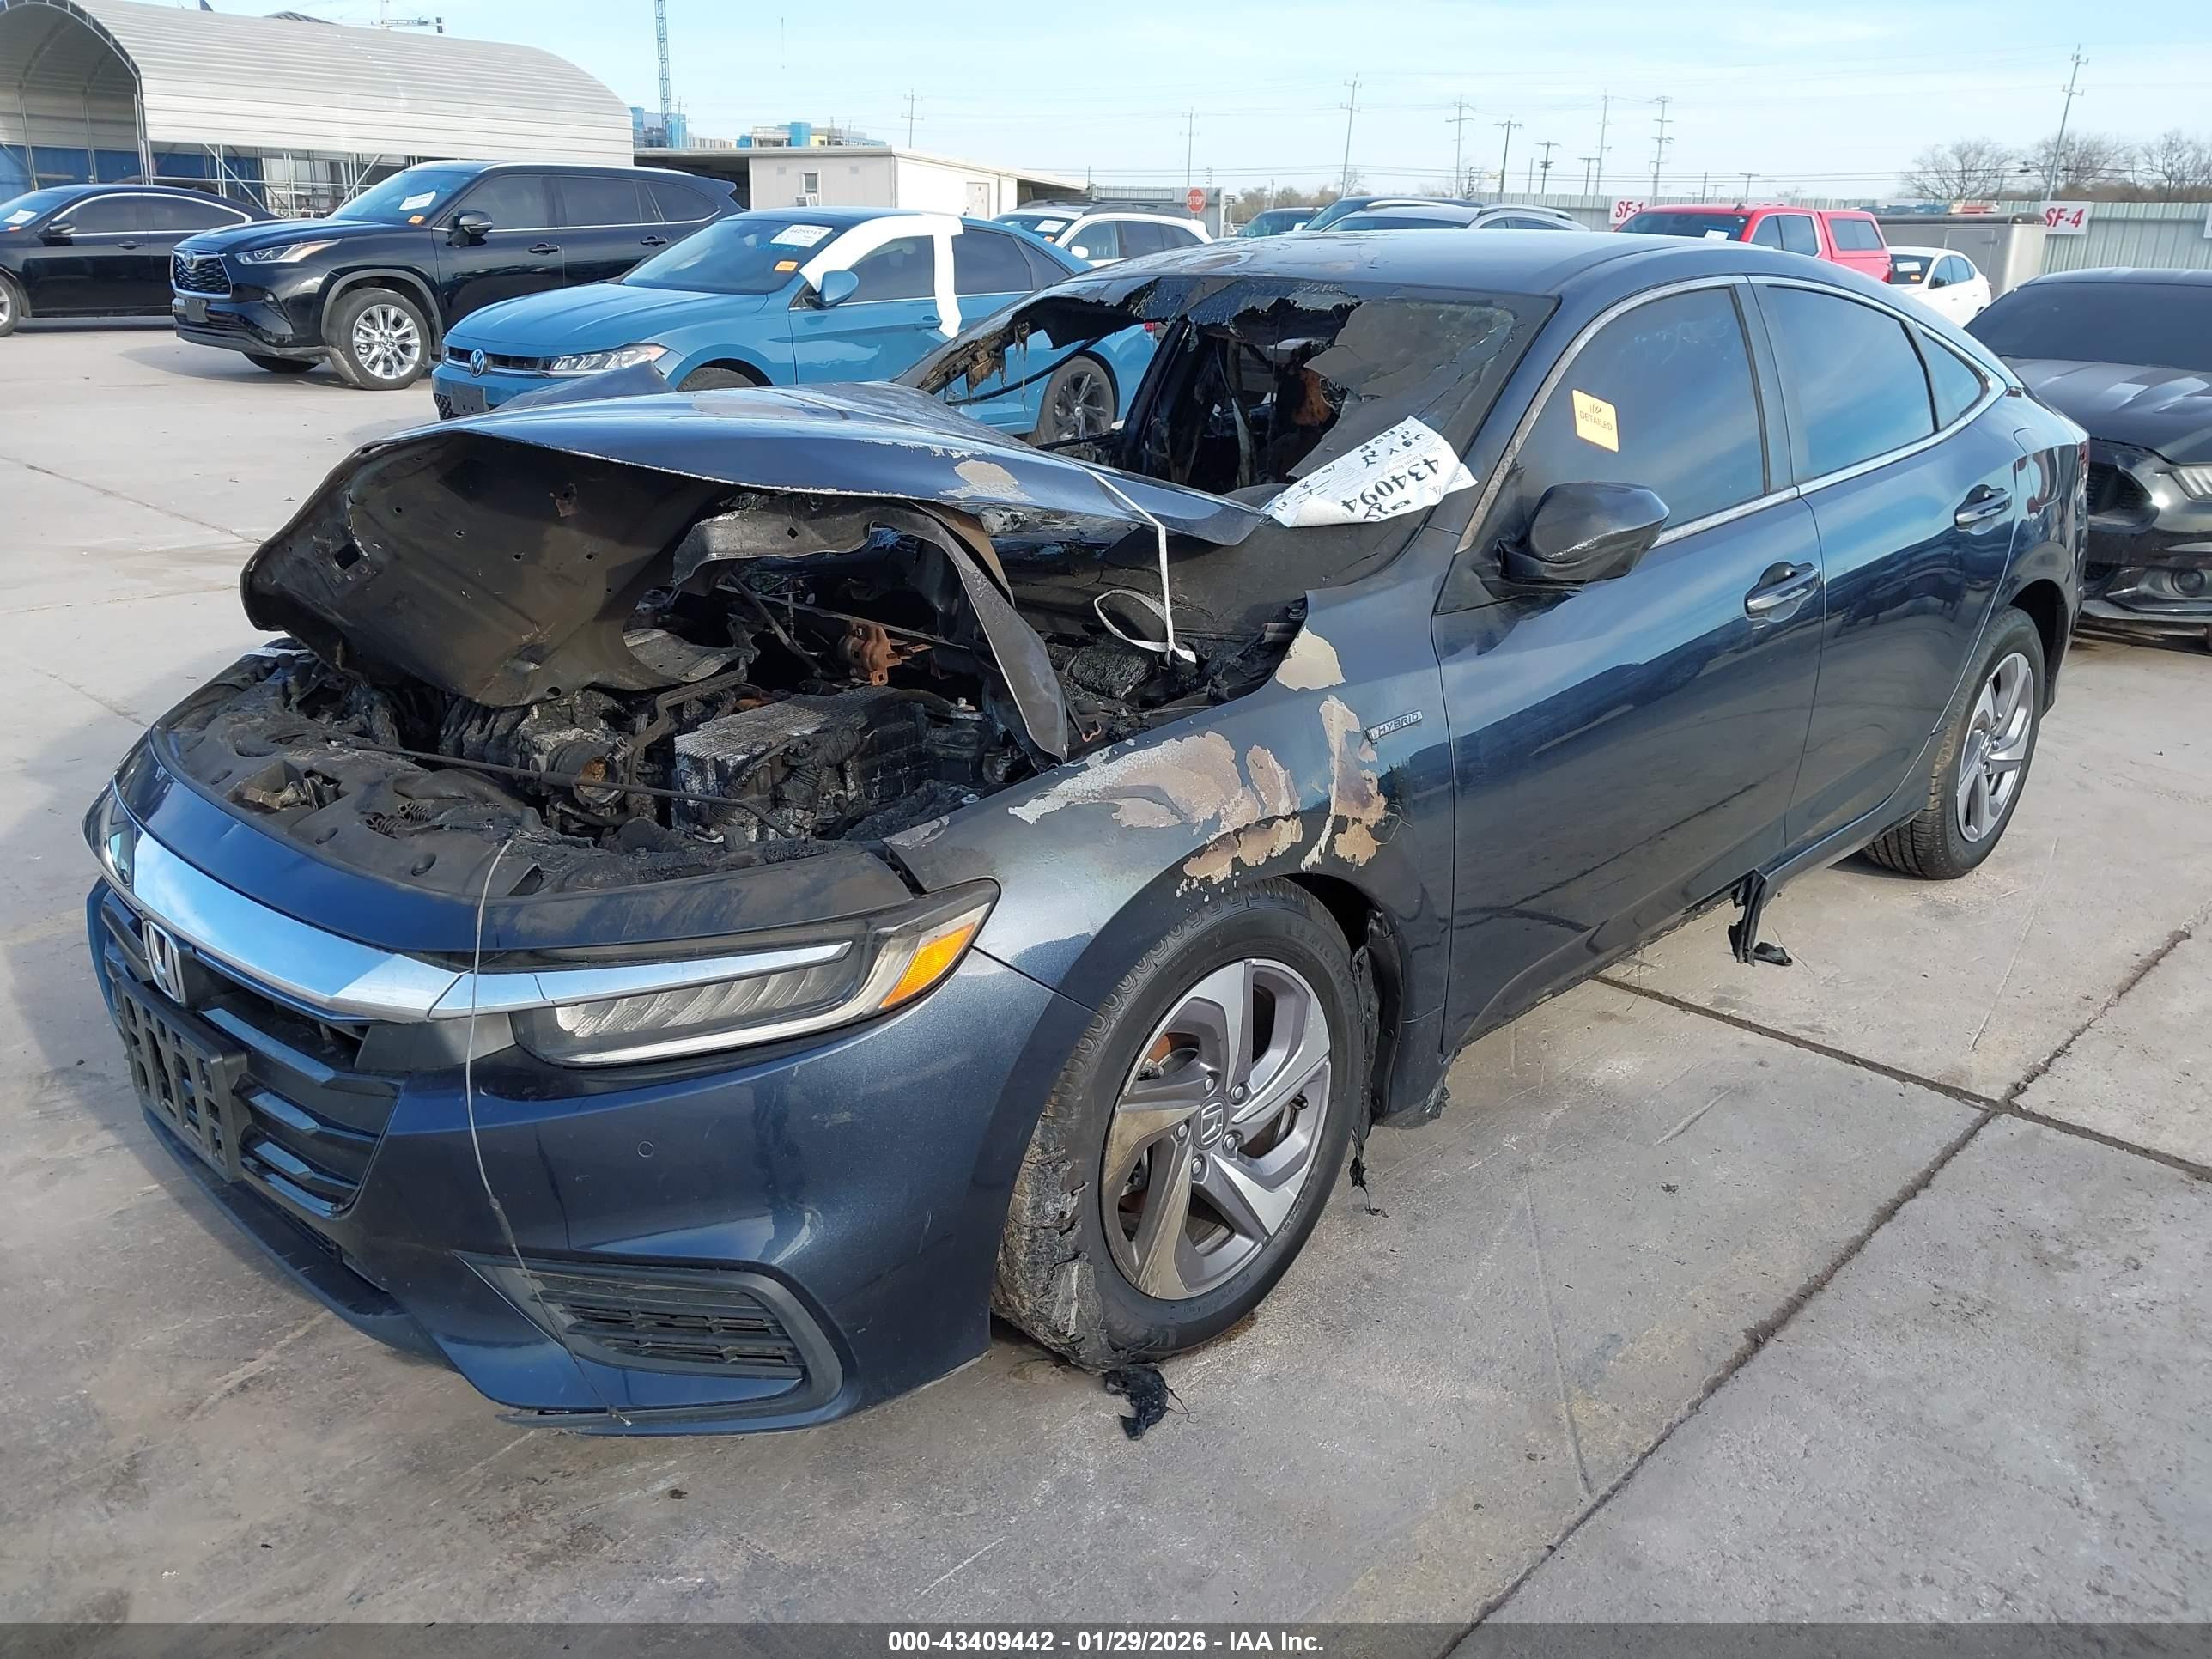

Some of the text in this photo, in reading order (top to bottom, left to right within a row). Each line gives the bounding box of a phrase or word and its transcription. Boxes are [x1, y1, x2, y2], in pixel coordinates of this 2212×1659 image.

[1188, 196, 1203, 205] STOP
[2045, 208, 2084, 228] SF-4
[1579, 410, 1613, 431] DETAILED
[1377, 713, 1419, 737] HYBRID
